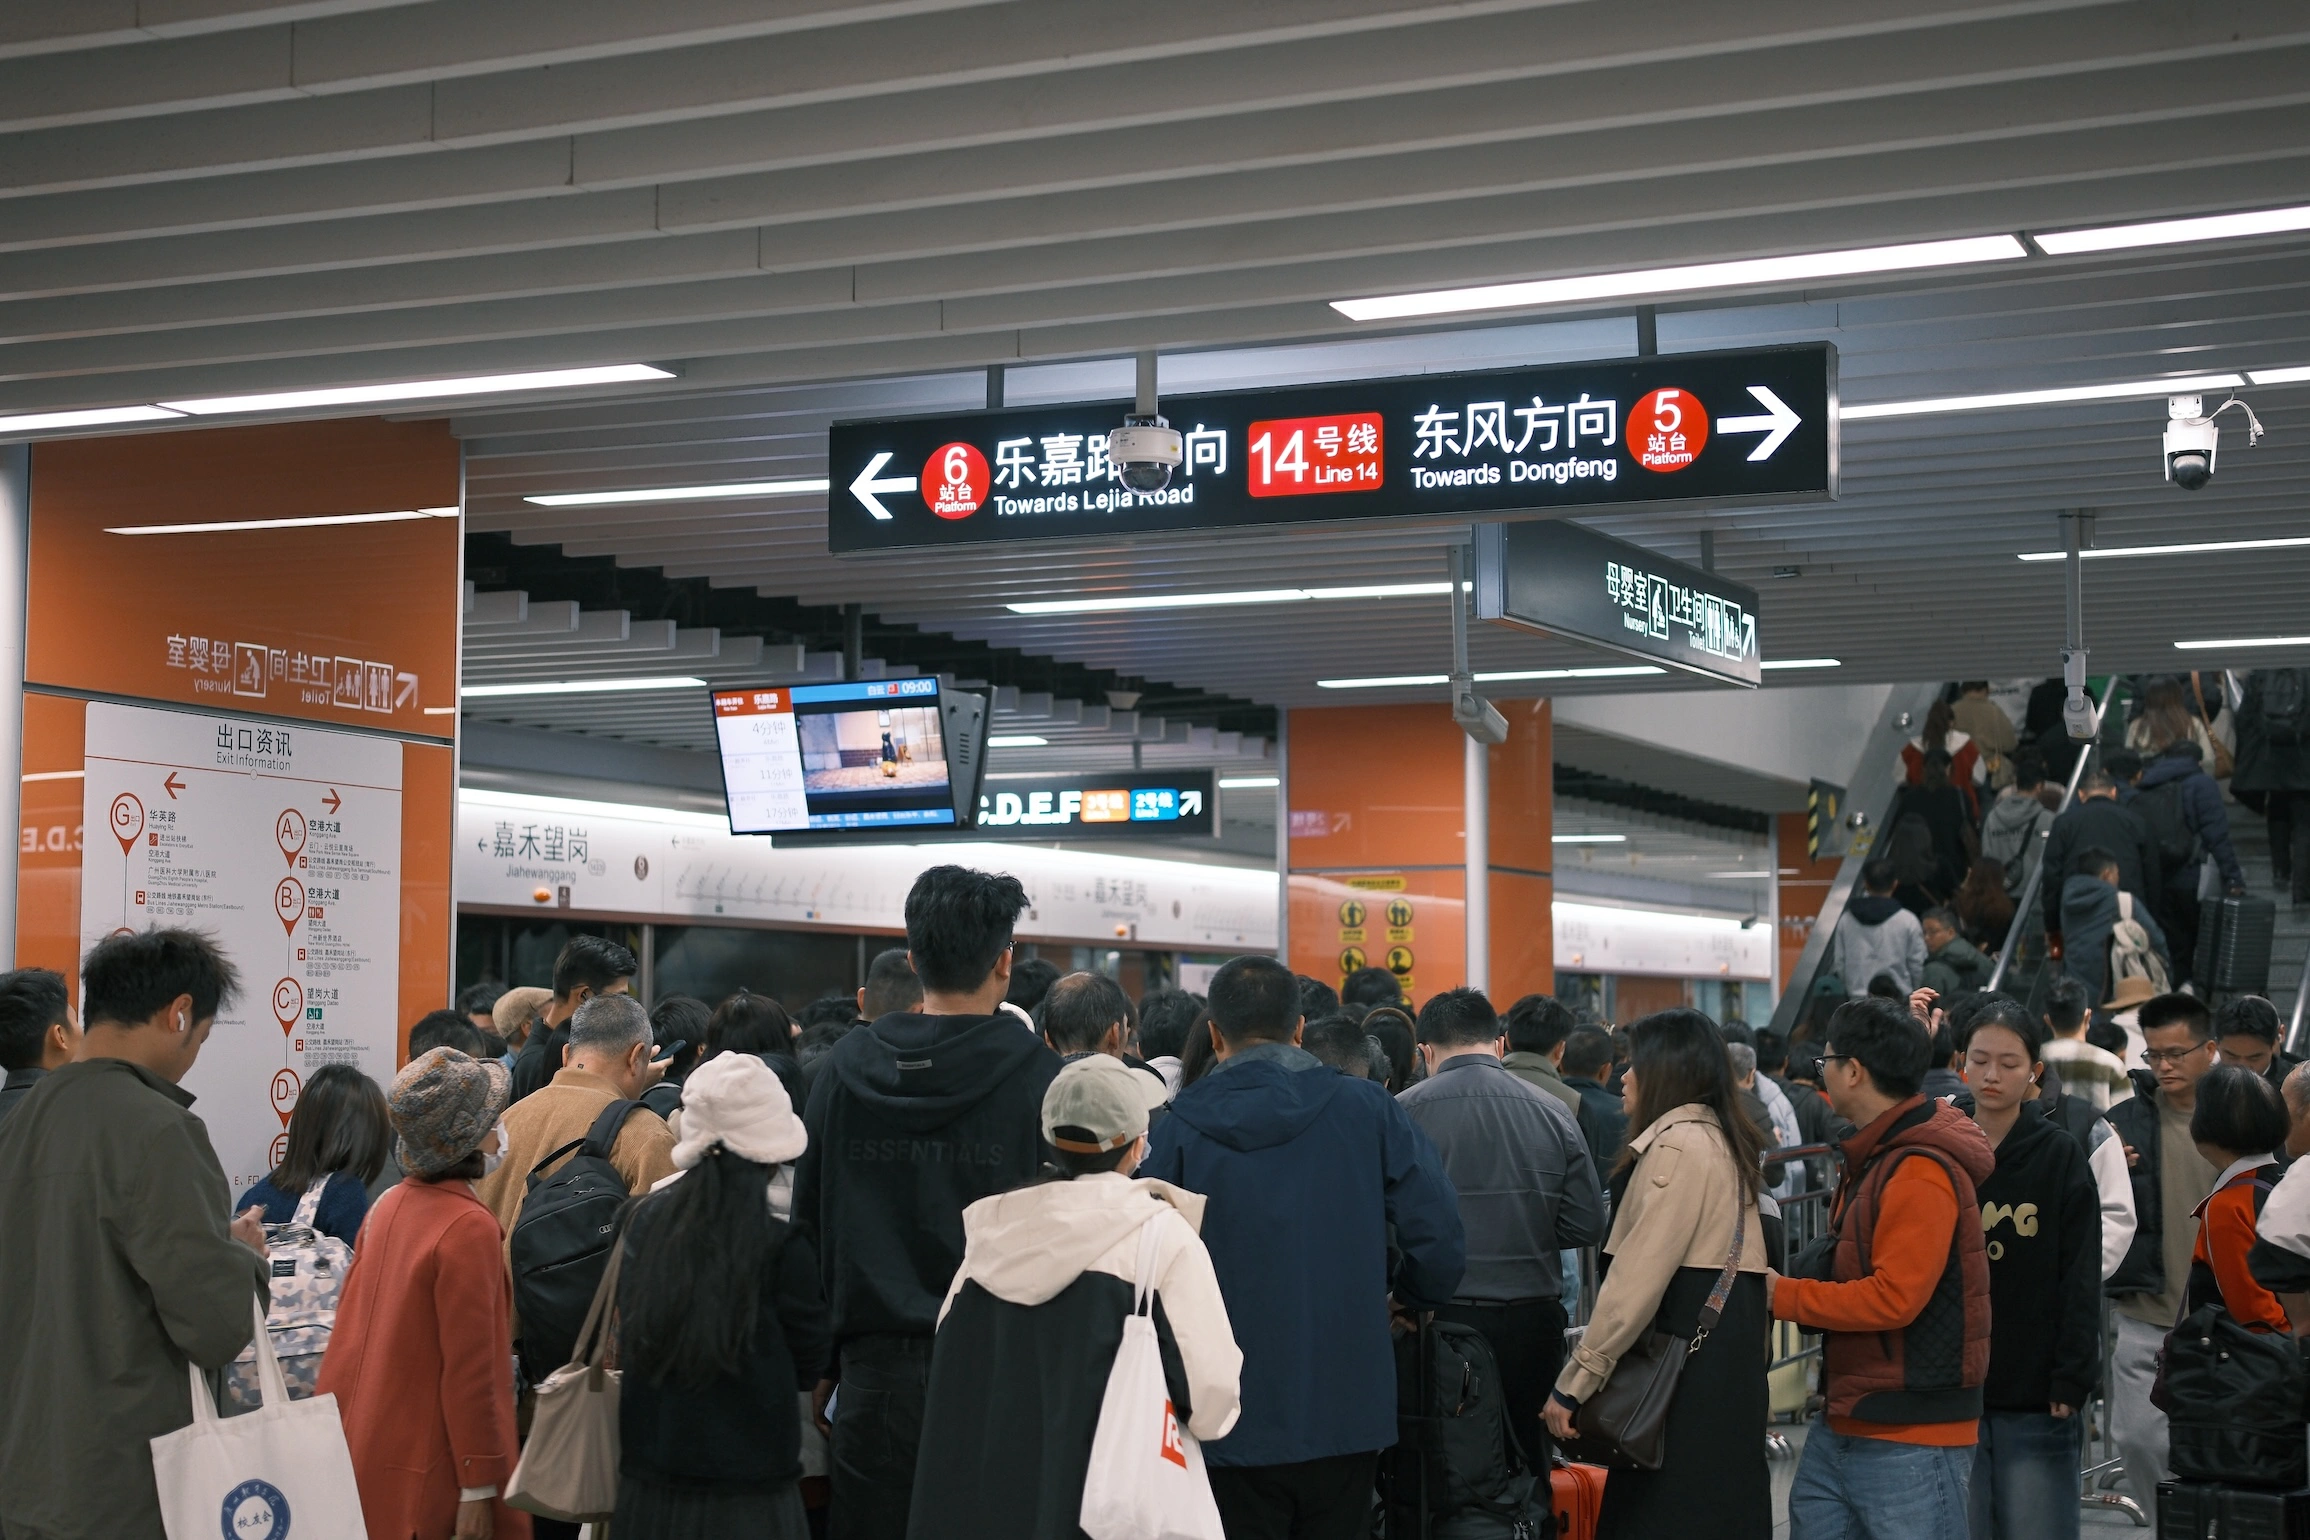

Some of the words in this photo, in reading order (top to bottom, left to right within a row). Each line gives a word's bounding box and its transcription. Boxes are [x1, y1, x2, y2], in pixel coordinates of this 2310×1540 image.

[1653, 390, 1682, 433] 5
[1412, 392, 1618, 460] 东风方向
[1313, 422, 1379, 457] 号线
[1647, 431, 1688, 454] 站台
[943, 446, 968, 484] 6
[994, 423, 1227, 490] 乐嘉路向
[1250, 430, 1309, 485] 14
[1641, 451, 1693, 467] Platform
[1314, 463, 1352, 485] Line
[1355, 462, 1378, 482] 14
[1410, 464, 1500, 490] Towards
[1510, 456, 1618, 484] Dongfeng
[939, 483, 973, 502] 站台
[993, 490, 1079, 517] Towards
[1083, 489, 1133, 514] Lejia
[1139, 482, 1194, 507] Road
[934, 499, 977, 514] Platform
[1606, 560, 1649, 613] 母婴室
[1668, 584, 1705, 632] 卫生间
[1623, 611, 1649, 638] Nursery
[1688, 630, 1706, 652] Toilet
[901, 680, 932, 694] 09:00
[216, 722, 293, 757] 出口资讯
[216, 751, 235, 766] Exit
[235, 752, 291, 771] Information
[115, 802, 129, 825] G
[149, 809, 176, 822] 华英路
[148, 823, 167, 831] Huaying
[281, 817, 294, 840] A
[309, 819, 341, 833] 空港大道
[493, 820, 589, 864] 嘉禾望岗
[148, 849, 171, 859] 空港大道
[505, 863, 577, 885] Jiahewanggang
[281, 886, 293, 908] B
[308, 887, 340, 900] 空港大道
[277, 986, 290, 1010] C
[306, 987, 339, 1000] 望岗大道
[276, 1079, 289, 1101] D
[275, 1142, 287, 1164] E
[847, 1138, 1006, 1167] ESSENTIALS
